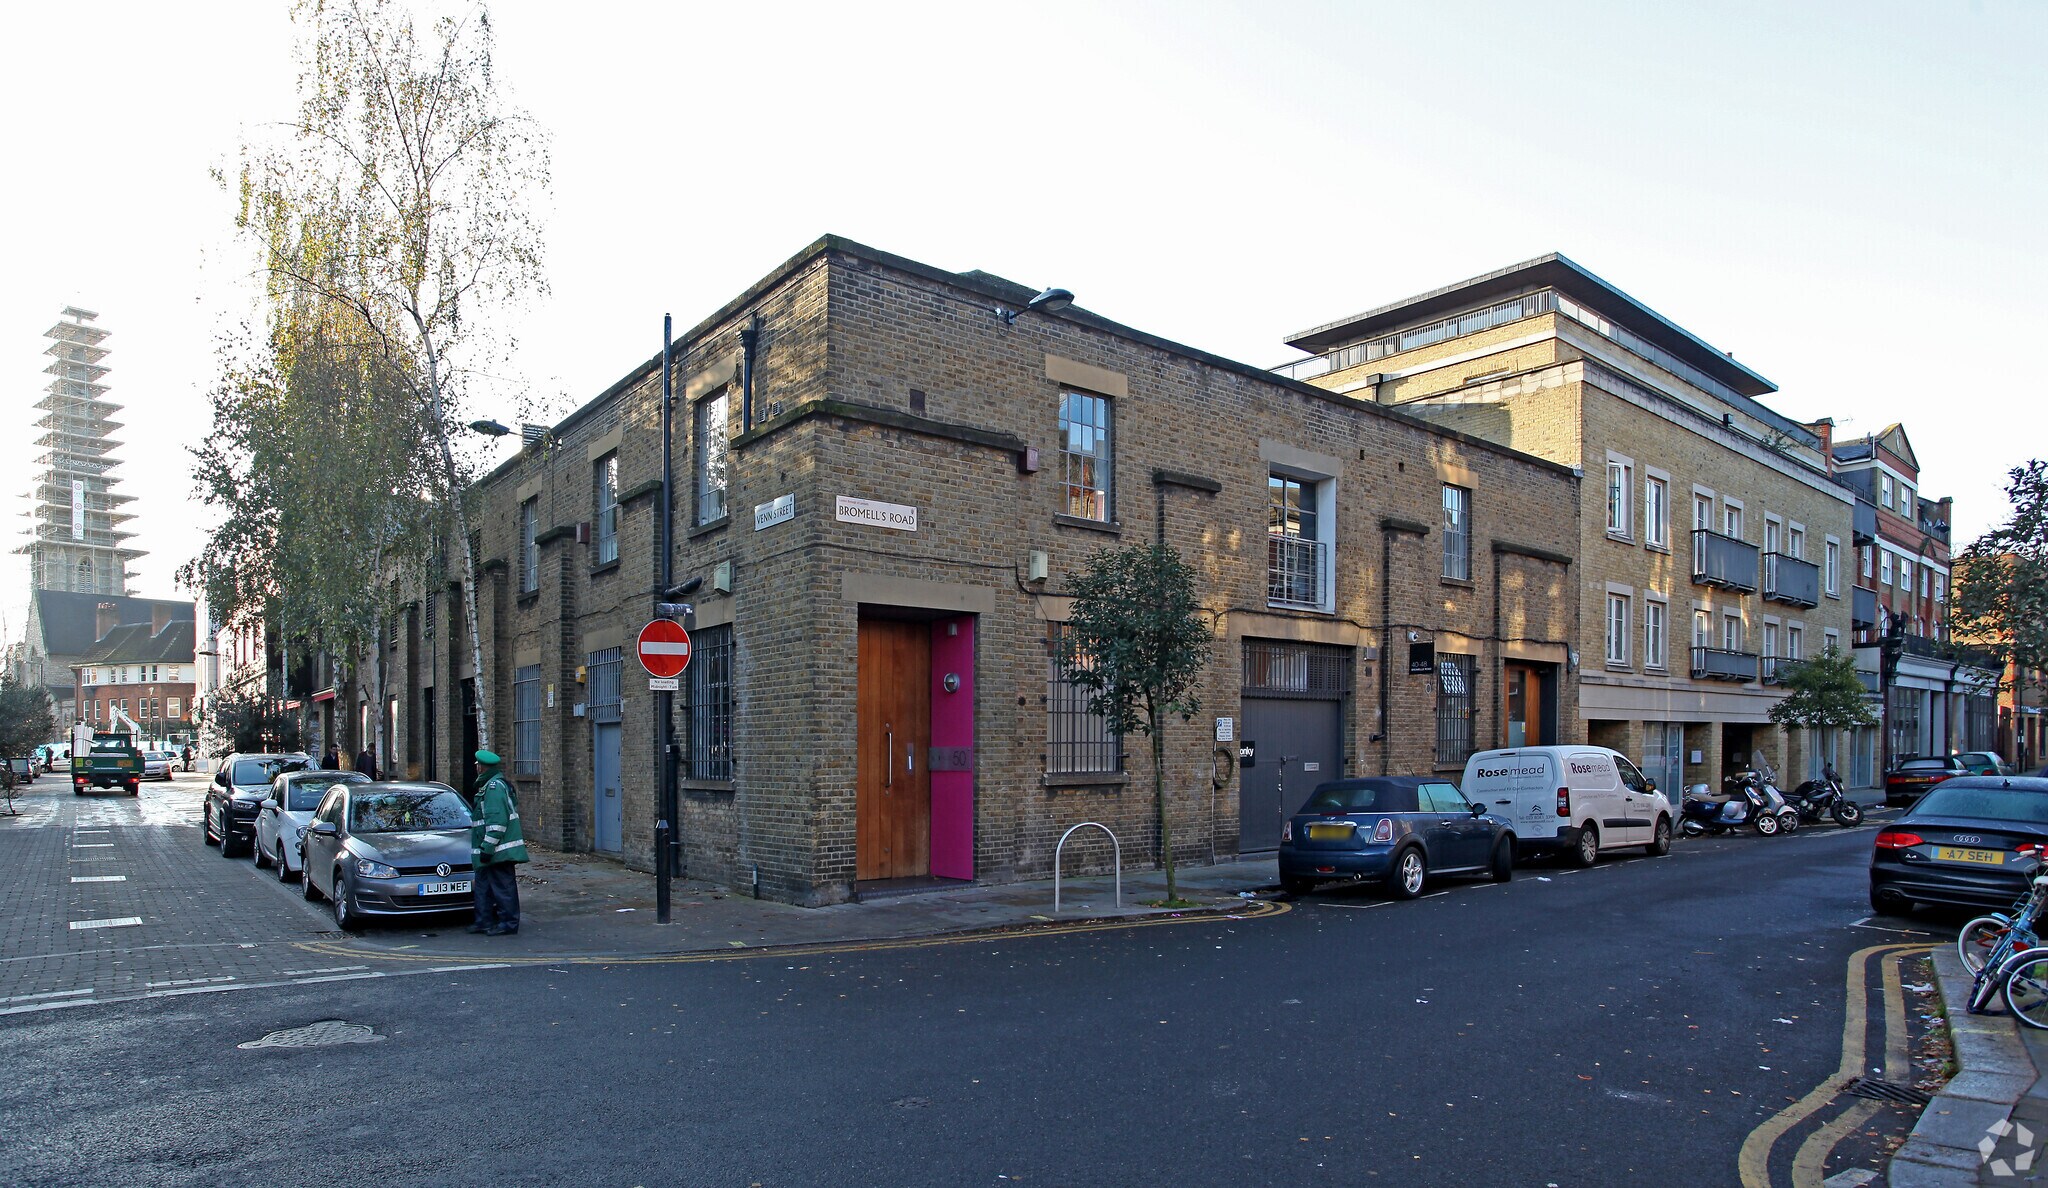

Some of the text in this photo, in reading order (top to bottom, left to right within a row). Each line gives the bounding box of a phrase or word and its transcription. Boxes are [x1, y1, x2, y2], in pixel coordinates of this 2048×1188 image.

[756, 511, 773, 524] VENN
[773, 503, 793, 519] STREET
[839, 505, 915, 525] BROMELL'S ROAD
[952, 750, 967, 767] 50
[1949, 849, 1993, 862] A7 SEH
[427, 882, 468, 893] LJ13 WEF
